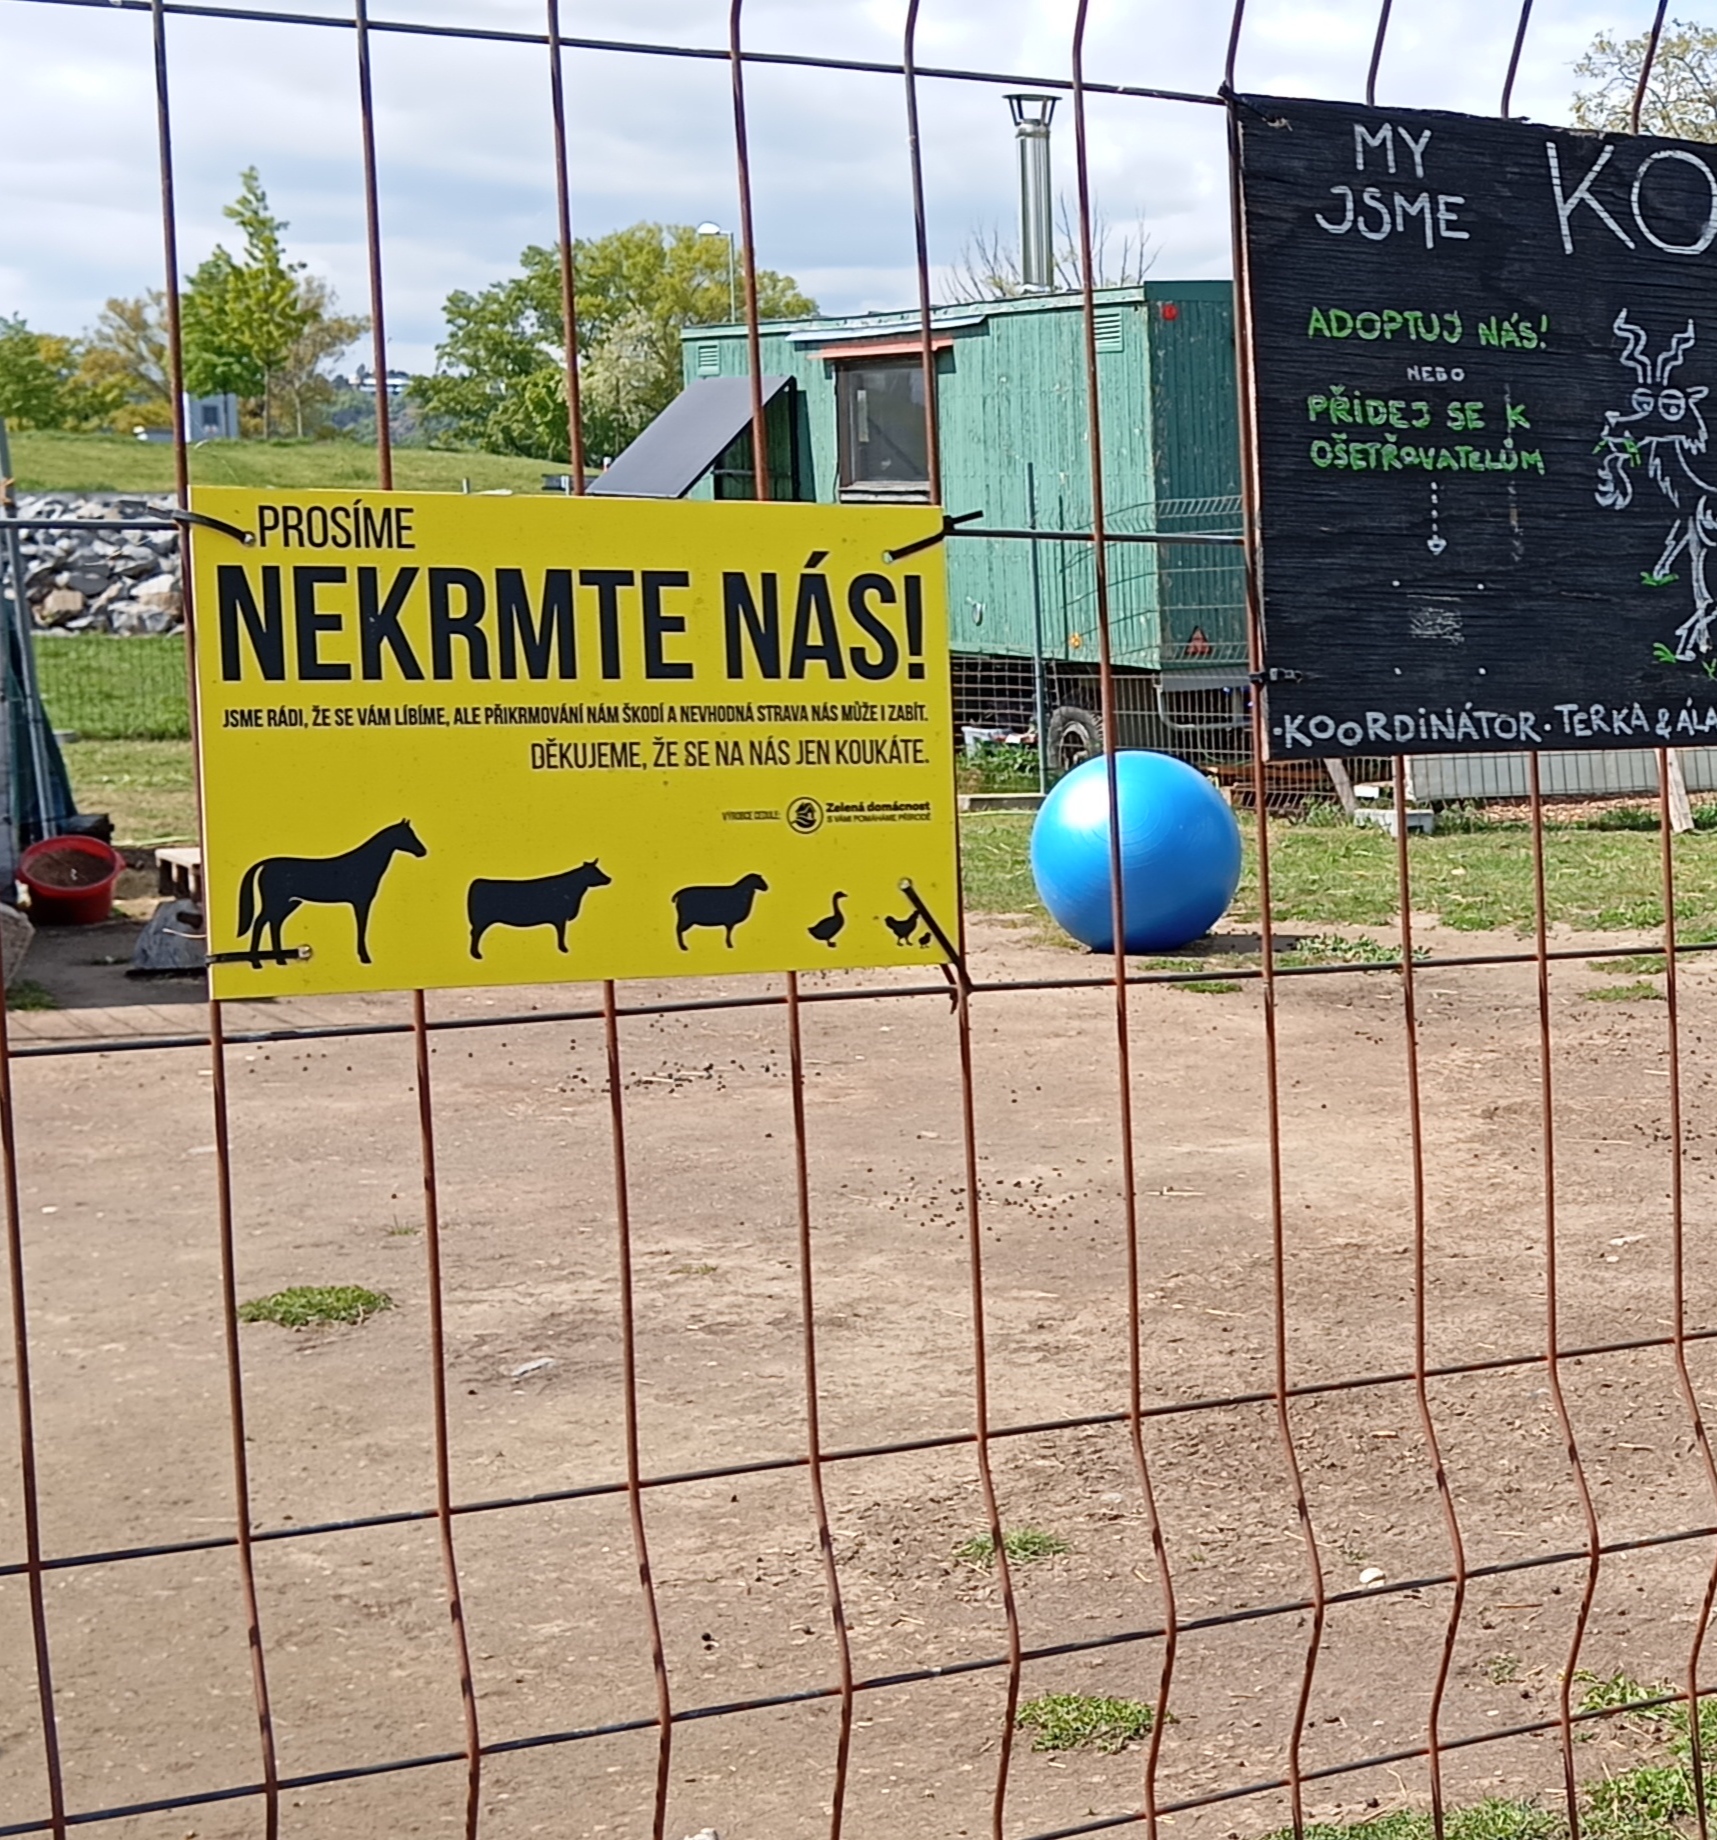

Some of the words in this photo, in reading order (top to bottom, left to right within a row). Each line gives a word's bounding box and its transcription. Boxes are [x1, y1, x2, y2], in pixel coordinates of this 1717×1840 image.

[1353, 122, 1433, 178] MY
[1315, 184, 1471, 250] JSME
[1307, 307, 1464, 344] ADOPTUJ
[1478, 312, 1548, 350] NÁS!
[1407, 365, 1466, 383] NEBO
[1446, 401, 1486, 432] SE
[1506, 404, 1532, 430] K
[256, 499, 416, 550] PROSÍME
[215, 564, 695, 682] NEKRMTE
[722, 550, 927, 680] NÁS!
[222, 708, 264, 728] JSME
[266, 705, 309, 729] RÁDI,
[312, 705, 331, 727] ŽE
[334, 708, 354, 727] SE
[356, 705, 391, 726] VÁM
[394, 704, 450, 727] LÍBÍME,
[453, 707, 481, 725] ALE
[484, 703, 584, 725] PŘIKRMOVÁNÍ
[587, 703, 619, 723] NÁM
[622, 703, 665, 723] ŠKODÍ
[667, 705, 677, 723] A
[680, 702, 755, 723] NEVHODNÁ
[757, 704, 809, 722] STRAVA
[811, 702, 838, 722] NÁS
[841, 701, 878, 721] MŮŽE
[888, 702, 929, 721] ZABÍT.
[1655, 708, 1671, 739] &
[531, 738, 648, 770] DĚKUJEME,
[652, 737, 679, 767] ŽE
[684, 741, 709, 767] SE
[714, 741, 744, 766] NA
[749, 736, 790, 766] NÁS
[795, 740, 830, 765] JEN
[834, 735, 930, 765] KOUKÁTE.
[826, 803, 864, 812] Zelená
[867, 801, 930, 812] domácnost
